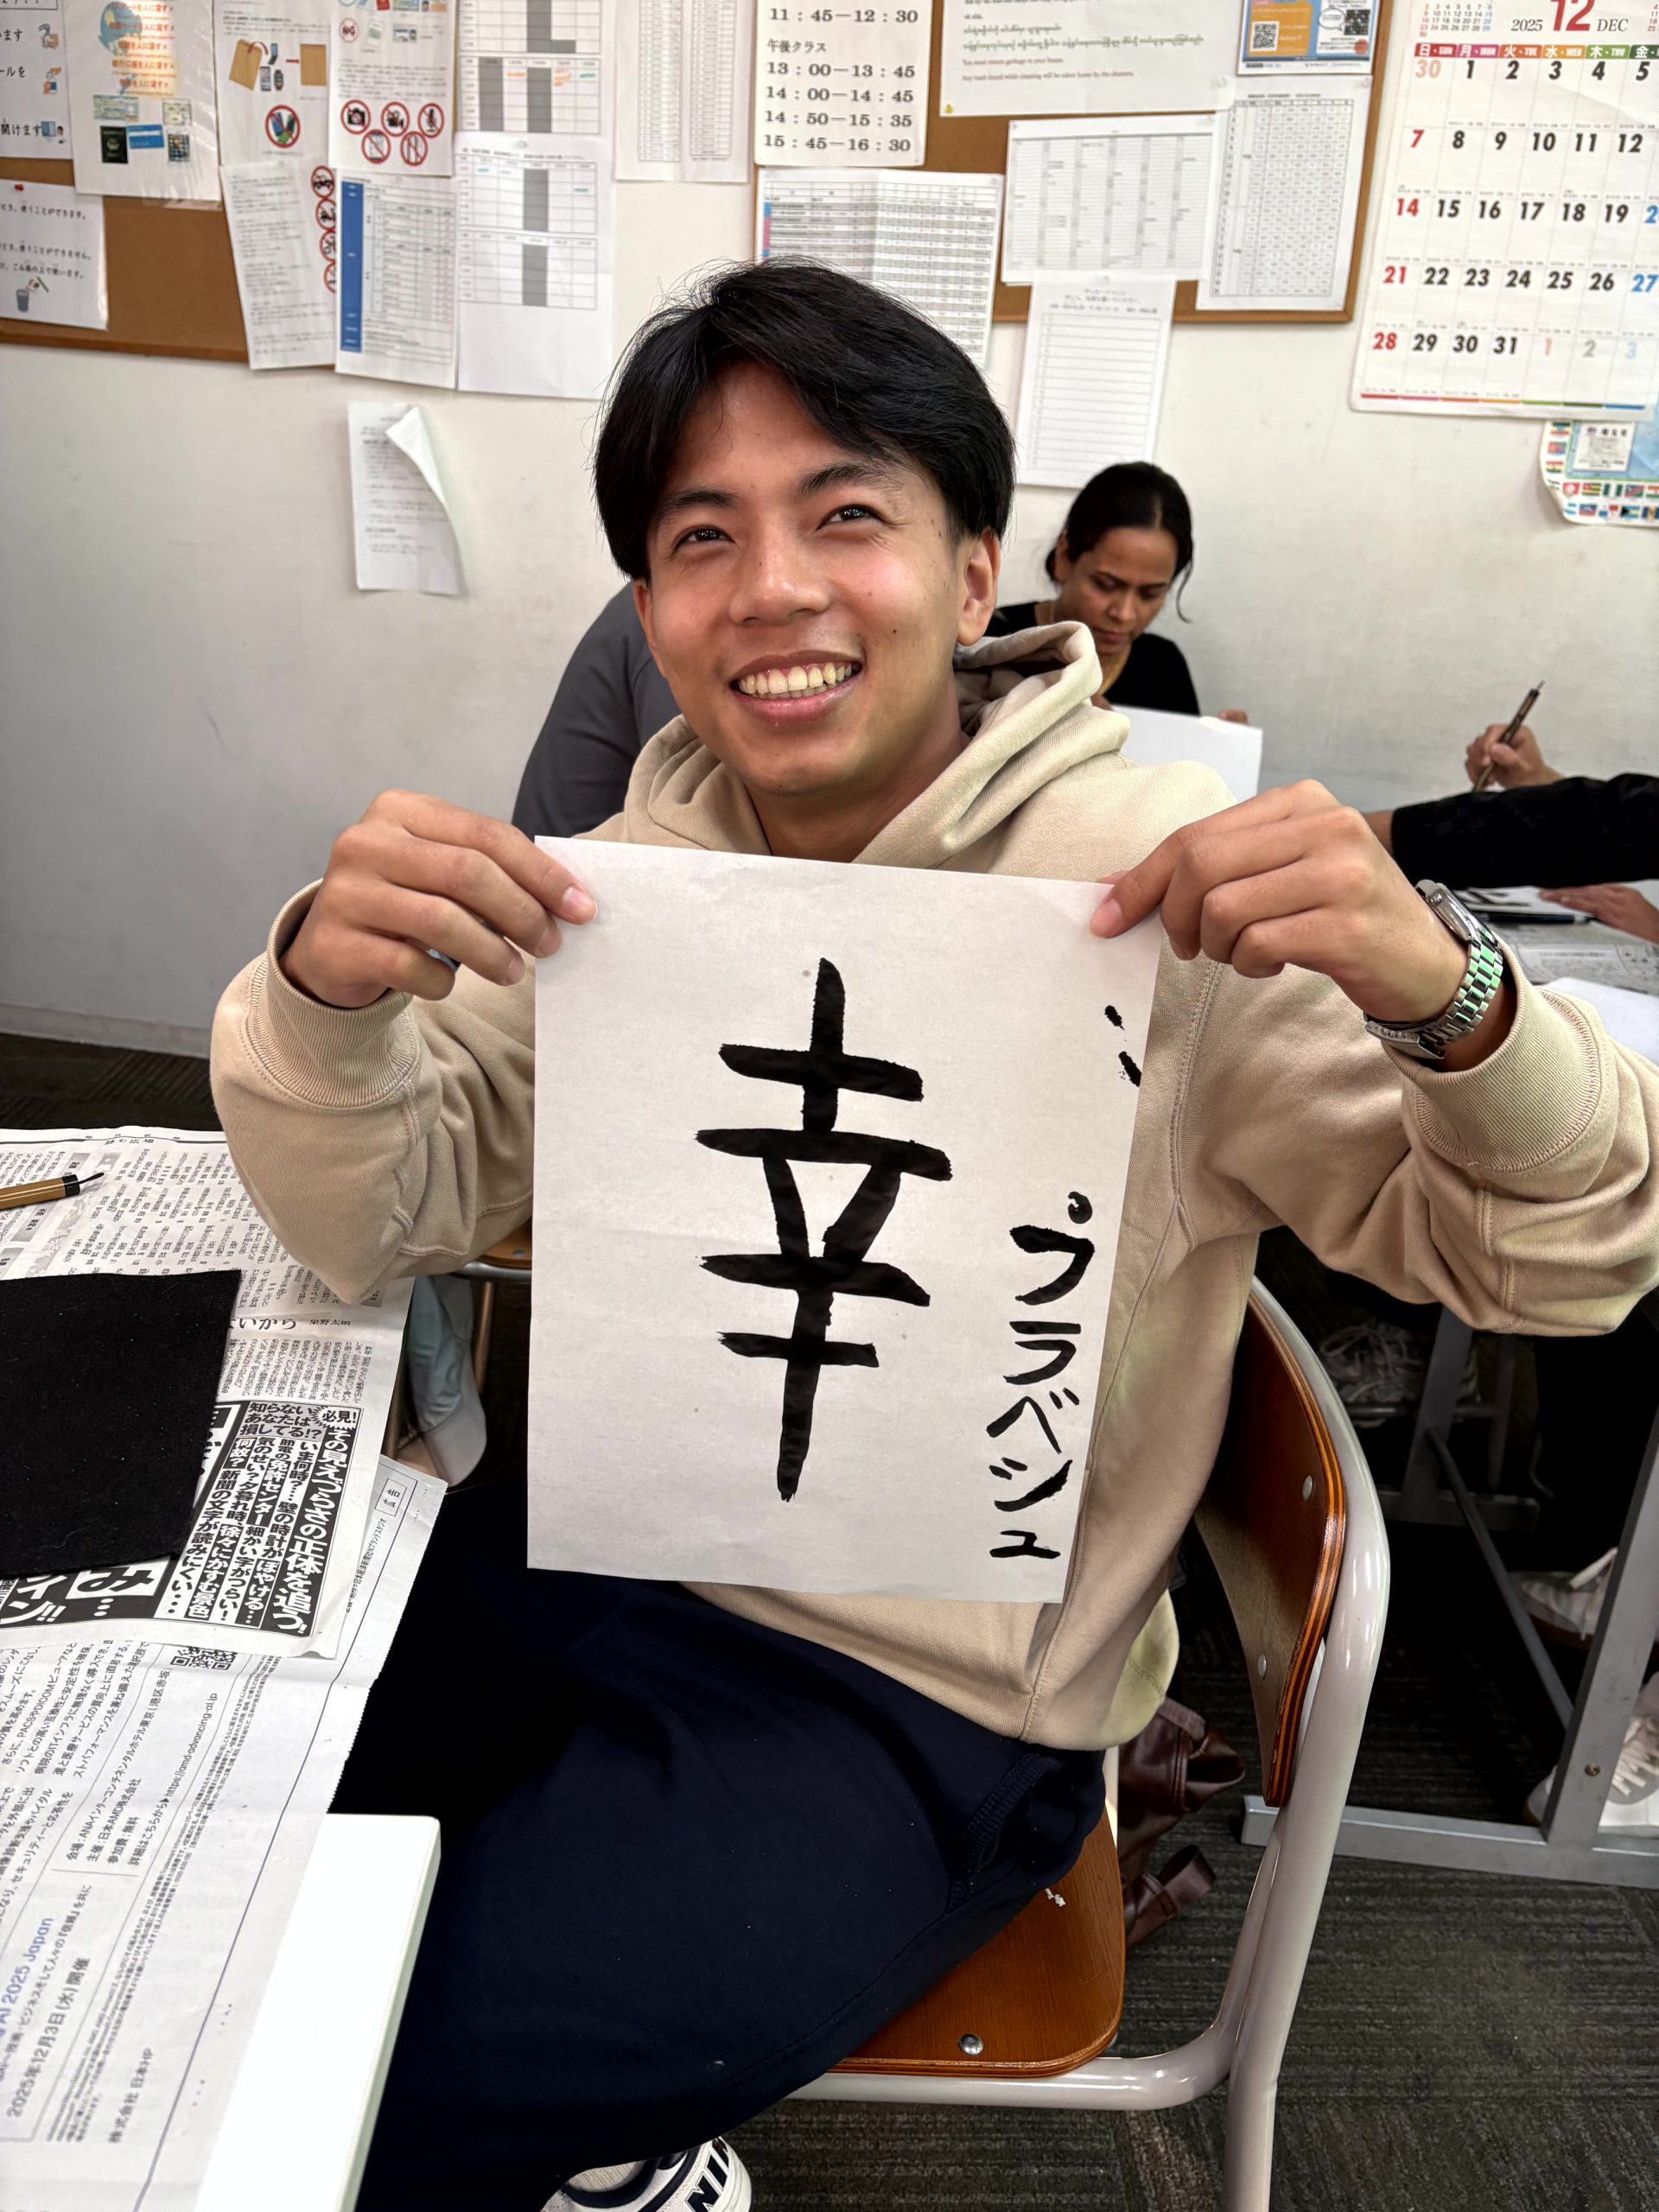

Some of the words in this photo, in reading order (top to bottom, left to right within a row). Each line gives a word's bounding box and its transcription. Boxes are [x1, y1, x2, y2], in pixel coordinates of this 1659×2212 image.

[1510, 19, 1543, 33] 2025
[1550, 0, 1595, 33] 12
[1597, 18, 1629, 33] DEC
[767, 38, 827, 54] 午後クラス
[1415, 60, 1441, 79] 30
[1466, 60, 1475, 79] 1
[1505, 60, 1519, 79] 2
[1548, 60, 1562, 80] 3
[1592, 60, 1605, 81] 4
[1636, 61, 1650, 81] 5
[1411, 130, 1424, 149] 7
[1452, 130, 1465, 149] 8
[1495, 131, 1507, 150] 9
[1532, 132, 1557, 151] 10
[1575, 133, 1598, 152] 11
[1618, 133, 1643, 153] 12
[1396, 198, 1419, 217] 14
[1438, 199, 1461, 218] 15
[1478, 200, 1502, 219] 16
[1521, 201, 1545, 220] 17
[1562, 202, 1586, 222] 18
[1605, 204, 1629, 223] 19
[1644, 205, 1659, 224] 2
[1382, 265, 1407, 284] 21
[1423, 267, 1450, 286] 22
[1464, 268, 1491, 287] 23
[1505, 270, 1532, 289] 24
[1547, 271, 1574, 289] 25
[1588, 272, 1615, 291] 26
[1630, 274, 1659, 292] 27
[1372, 332, 1397, 351] 28
[1413, 334, 1439, 352] 29
[1452, 335, 1478, 353] 30
[1493, 336, 1518, 355] 31
[1545, 338, 1553, 356] 1
[1583, 340, 1597, 358] 2
[1624, 340, 1637, 359] 3
[694, 958, 953, 1503] 幸
[245, 1414, 312, 1427] あなたは
[249, 1402, 315, 1416] 知らない
[321, 1409, 357, 1426] 必見!
[3, 1965, 30, 2005] 2025
[22, 1917, 54, 1962] Japan
